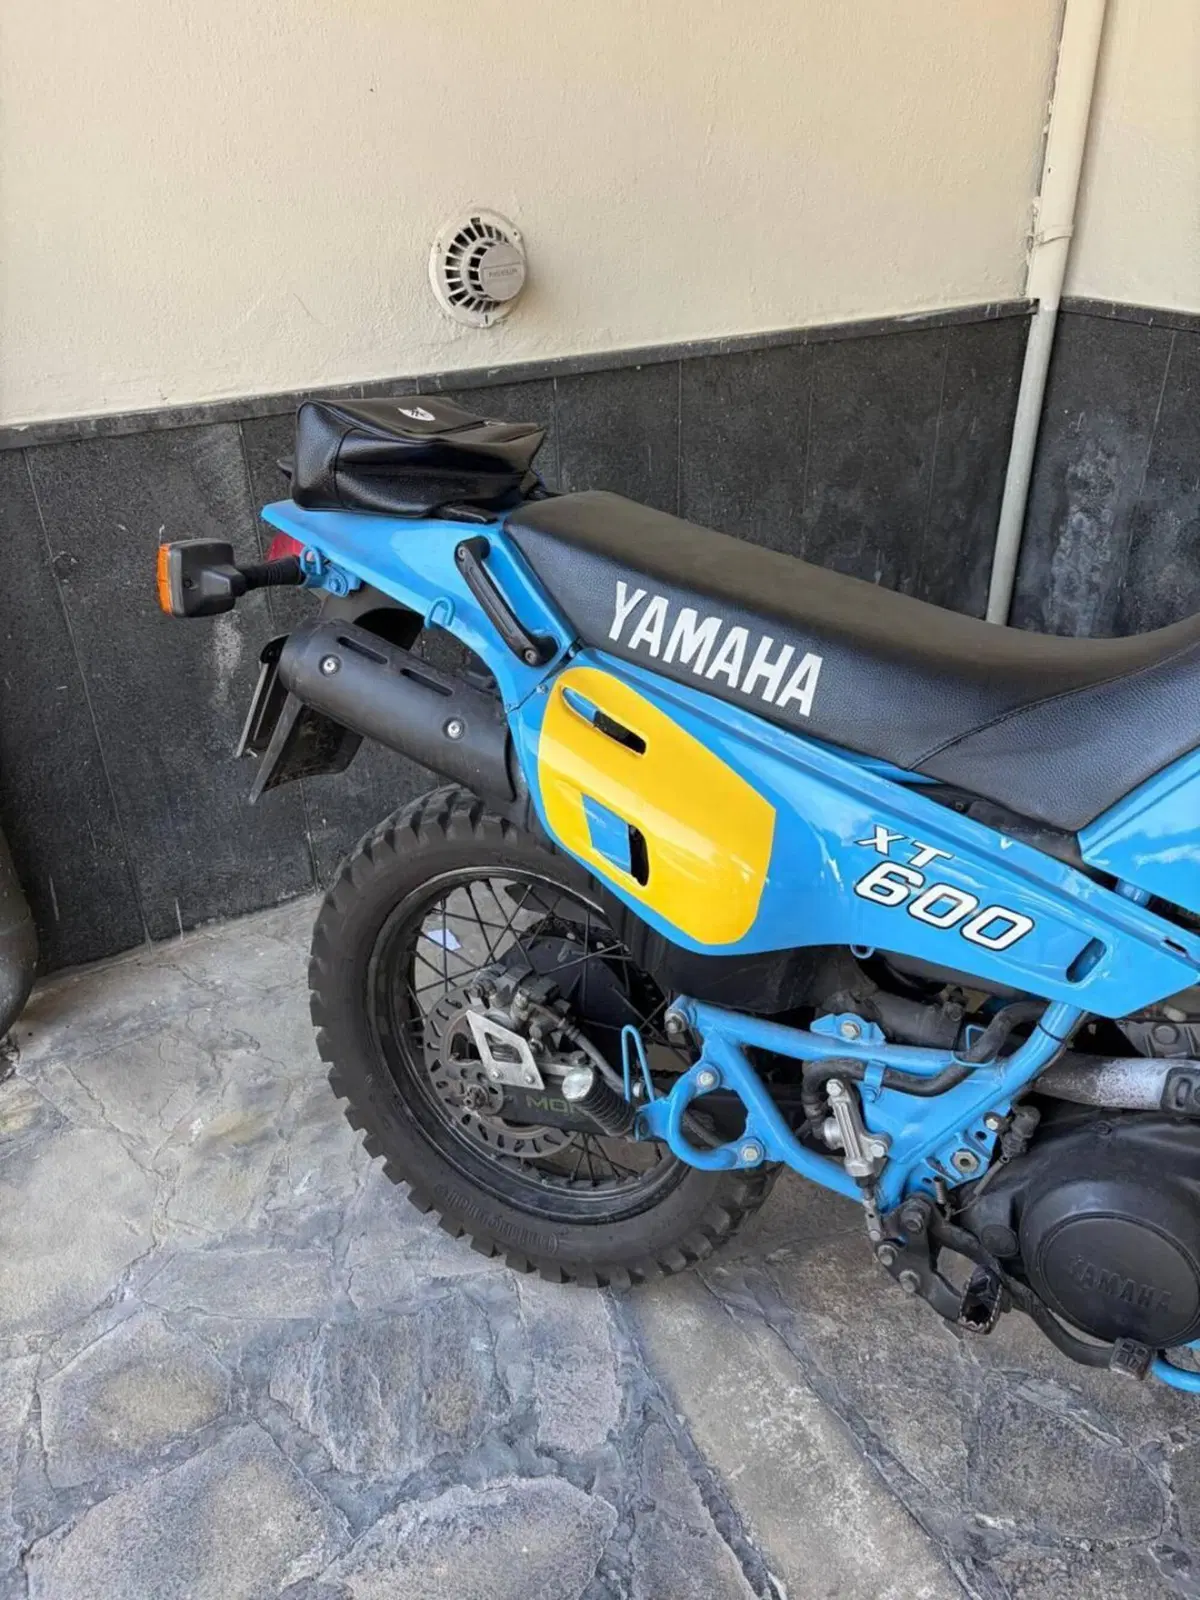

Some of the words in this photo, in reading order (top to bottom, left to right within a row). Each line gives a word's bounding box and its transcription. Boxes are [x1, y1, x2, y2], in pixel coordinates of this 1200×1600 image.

[608, 580, 823, 717] YAMAHA
[854, 824, 955, 869] XT
[853, 860, 1035, 951] 600
